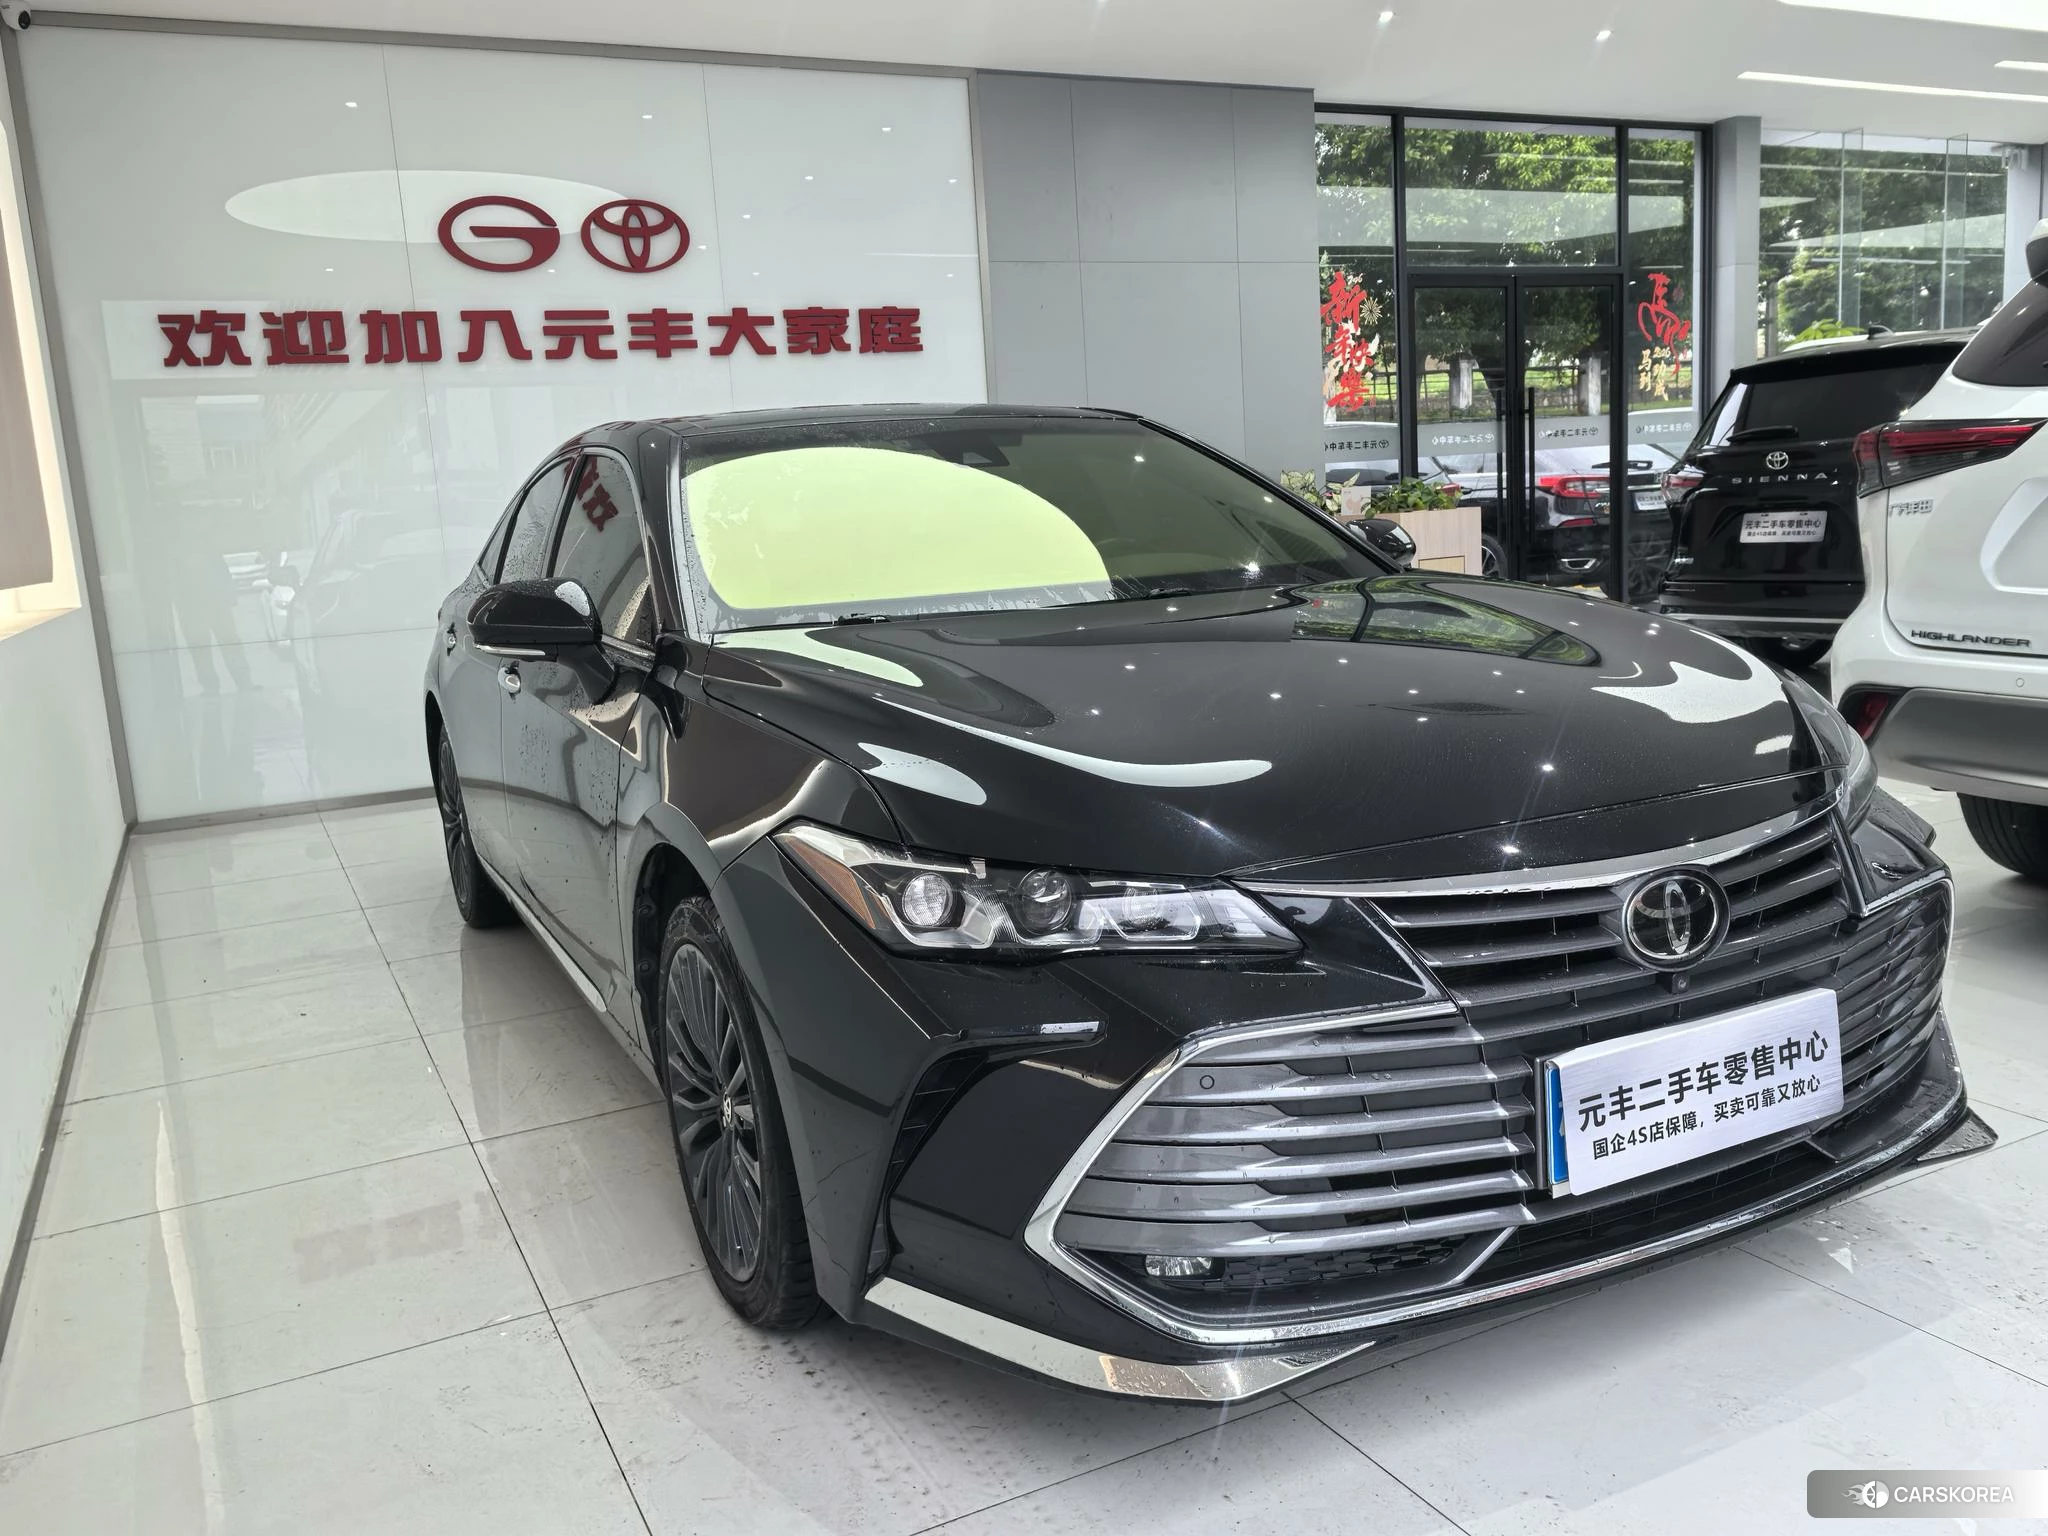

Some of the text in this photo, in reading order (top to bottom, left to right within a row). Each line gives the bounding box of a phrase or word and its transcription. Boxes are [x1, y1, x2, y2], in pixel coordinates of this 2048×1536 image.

[157, 308, 923, 367] 欢迎加入元丰大家庭
[1731, 472, 1828, 484] SIENNA
[1911, 629, 2032, 648] HIGHLANDER
[1578, 1030, 1829, 1133] 元丰二手车零售中心
